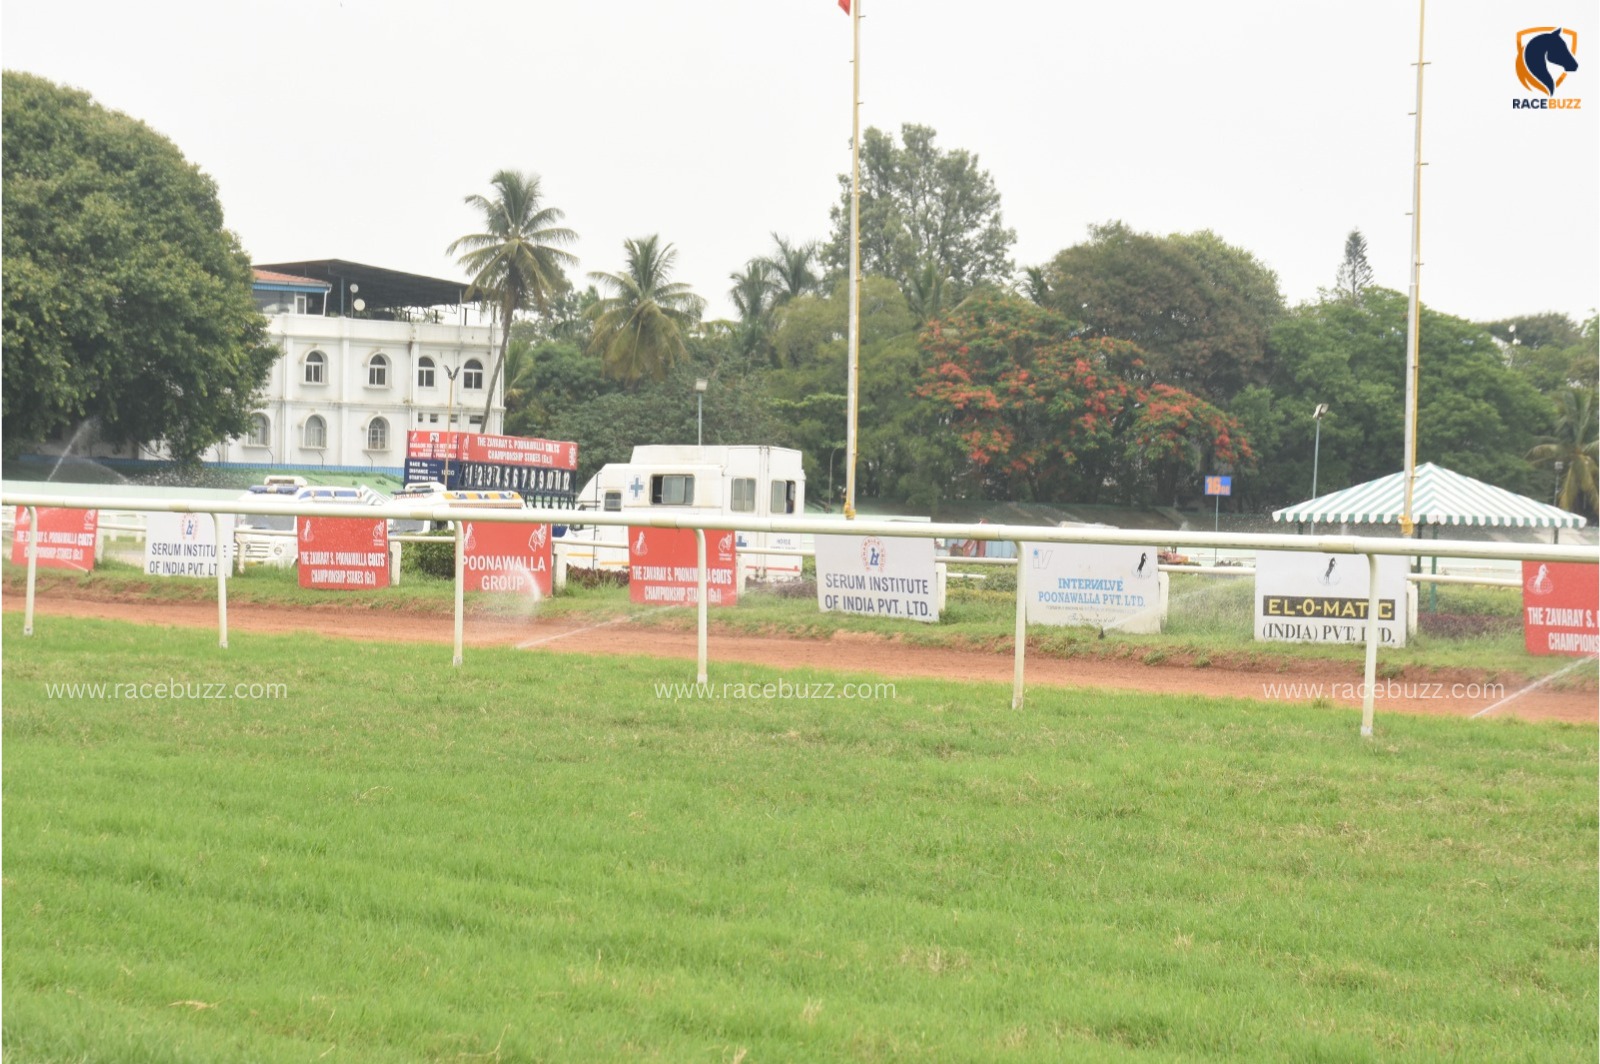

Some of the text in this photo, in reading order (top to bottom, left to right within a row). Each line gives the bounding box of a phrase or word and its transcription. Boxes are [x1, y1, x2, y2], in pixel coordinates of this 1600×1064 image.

[469, 465, 473, 485] 1
[477, 466, 483, 487] 2
[486, 466, 492, 486] 3
[504, 467, 510, 488] 5
[513, 468, 518, 488] 6
[522, 469, 528, 488] 7
[530, 470, 536, 488] 8
[539, 470, 544, 489] 9
[546, 471, 554, 490] 10
[555, 471, 561, 490] 11
[563, 472, 570, 490] 12
[152, 543, 226, 558] SERUM INSTITUE
[150, 561, 160, 574] OF
[163, 562, 185, 574] INDIA
[188, 563, 205, 576] PVT.
[632, 566, 642, 580] THE
[482, 575, 524, 590] GROUP
[826, 573, 928, 595] SERUM INSTITUTE
[1058, 578, 1124, 592] INTERVALVE
[644, 586, 686, 602] CHAMPIONSHIP
[1038, 591, 1146, 608] POONAWALLA PVT. LTD.
[825, 594, 932, 617] OF INDIA PVT. LTD.
[1268, 598, 1392, 618] EL-O-MATC
[1528, 607, 1544, 625] THE
[1545, 608, 1584, 627] ZAVARAY
[1586, 609, 1595, 628] S.
[1263, 623, 1318, 641] (INDIA)
[1323, 625, 1356, 642] PVT.
